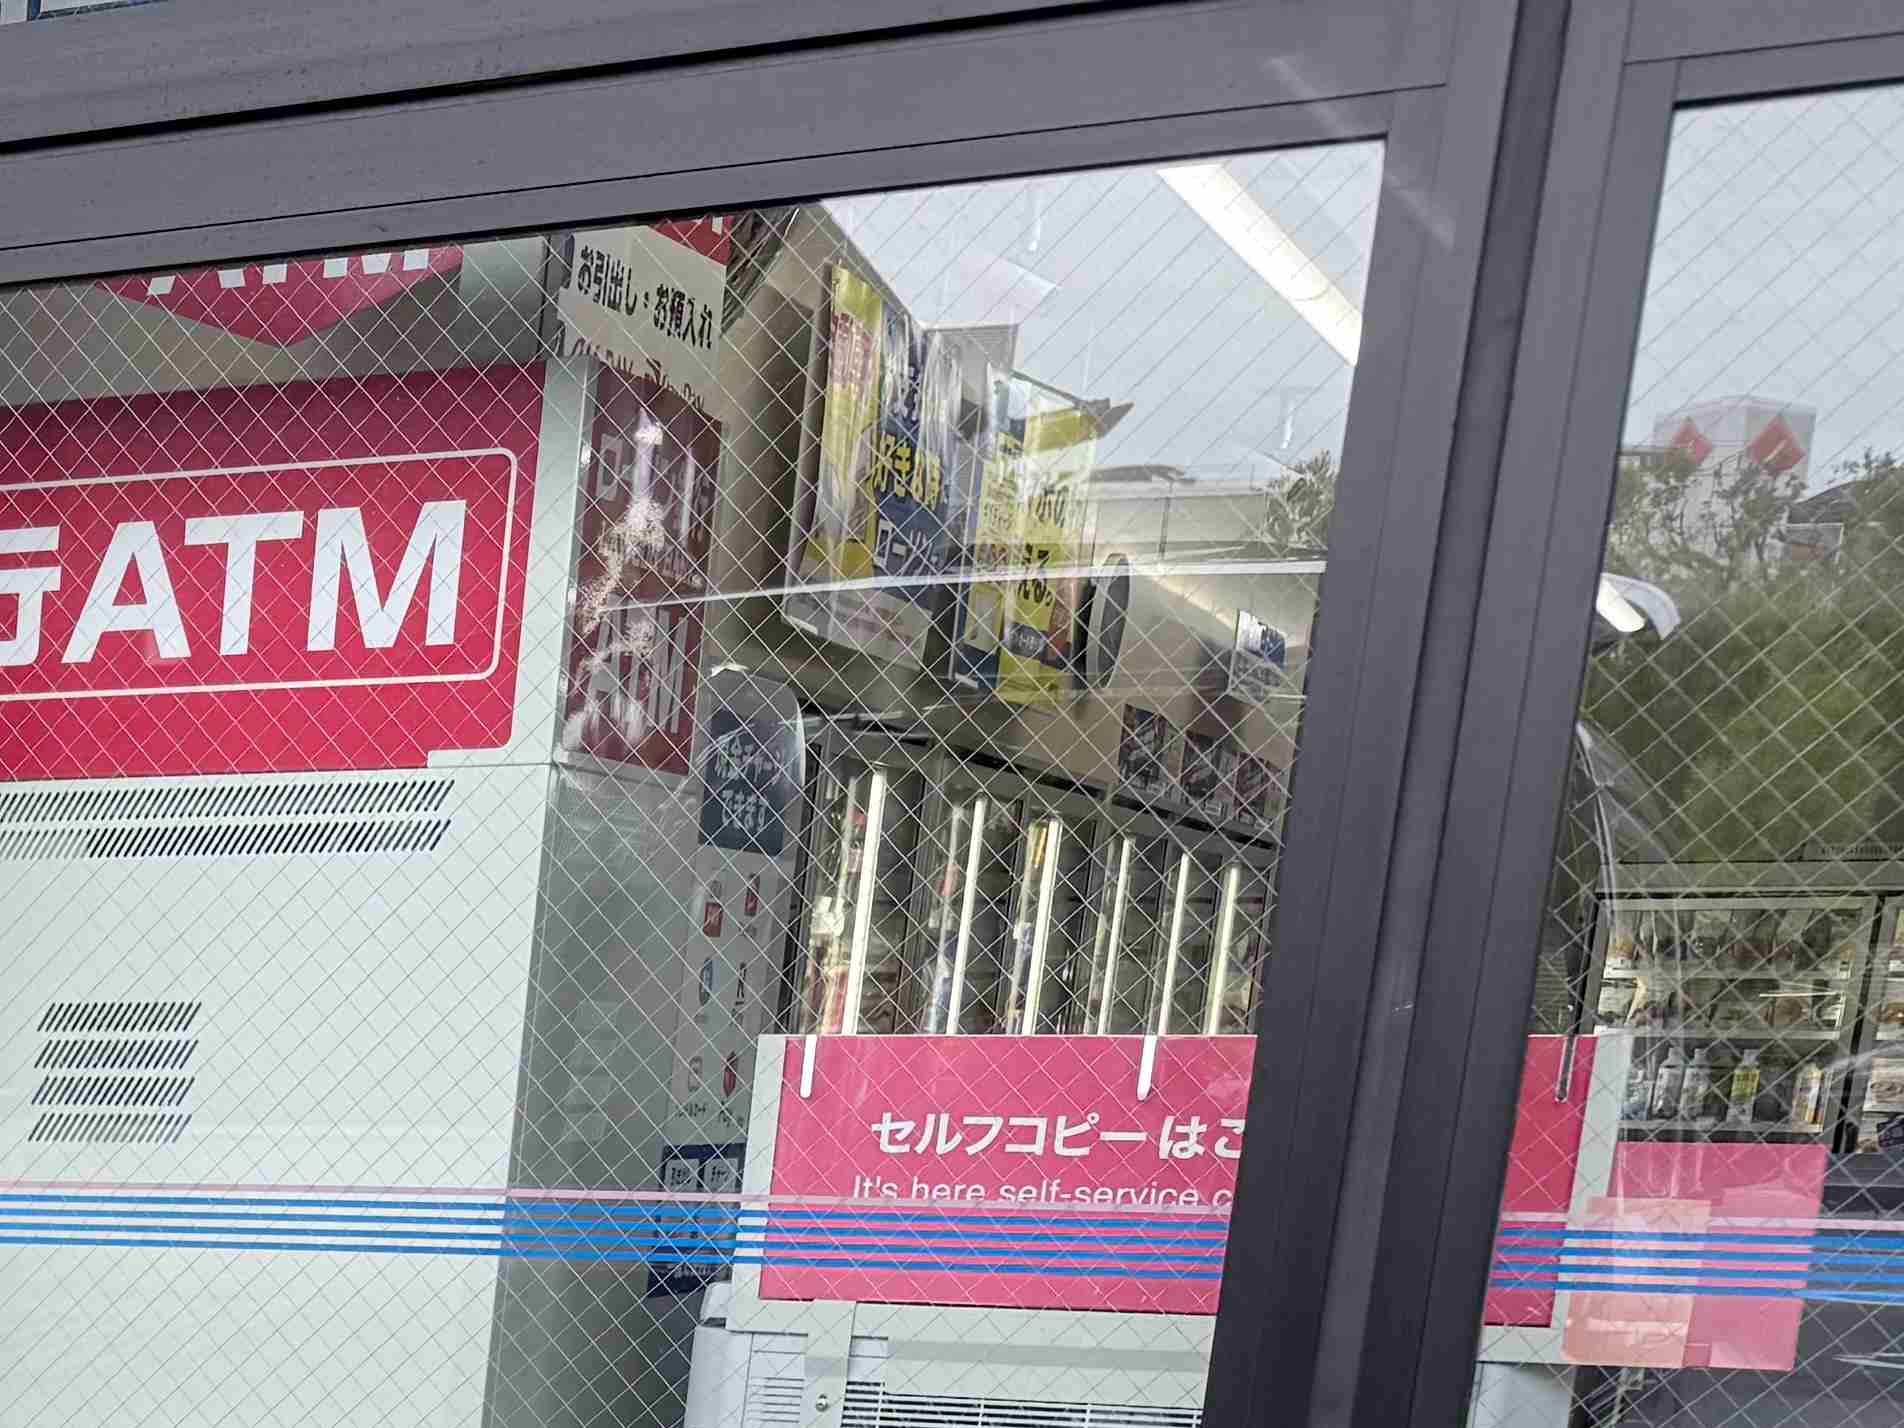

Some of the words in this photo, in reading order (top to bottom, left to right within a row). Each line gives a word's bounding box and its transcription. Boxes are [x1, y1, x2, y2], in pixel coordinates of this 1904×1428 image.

[853, 1175, 898, 1200] It's
[911, 1176, 987, 1201] here
[999, 1177, 1199, 1206] self-service
